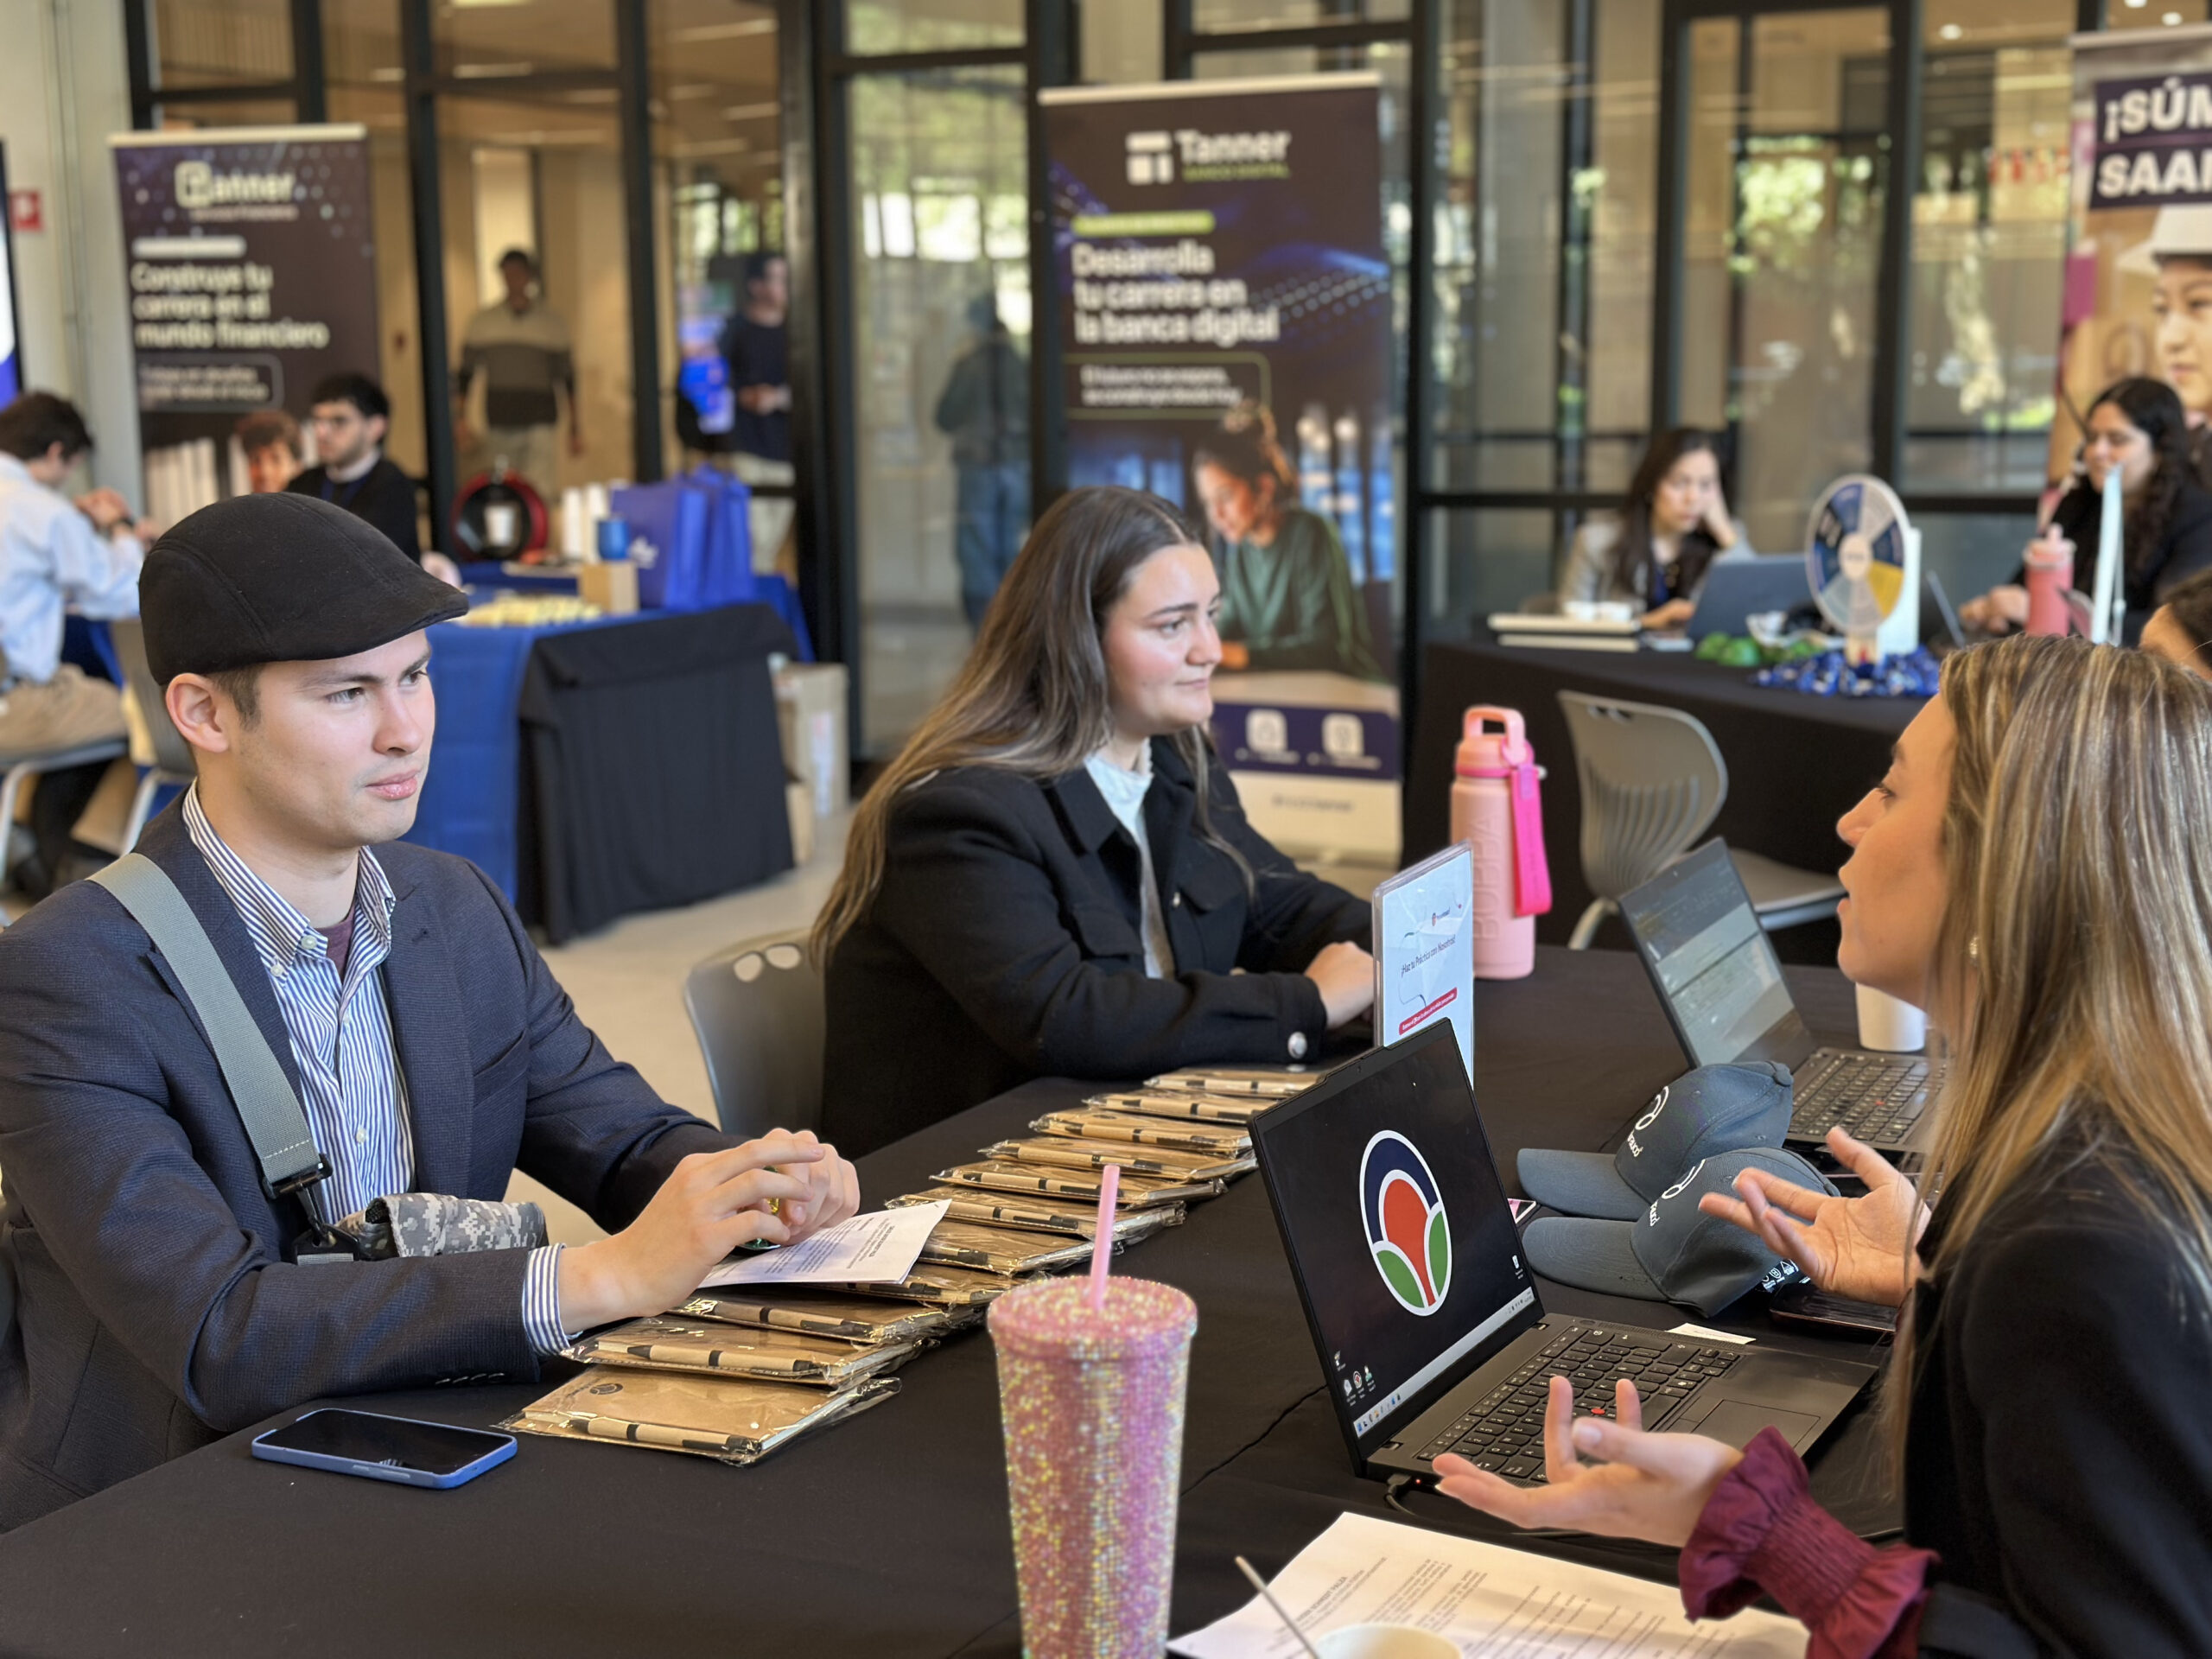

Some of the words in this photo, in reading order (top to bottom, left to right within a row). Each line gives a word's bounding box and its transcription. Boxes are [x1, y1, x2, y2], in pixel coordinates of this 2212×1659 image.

[1176, 130, 1291, 162] Tanner
[1072, 240, 1214, 276] Desarrolla
[132, 264, 243, 292] Construye
[245, 264, 272, 289] tu
[135, 296, 212, 318] carrera
[216, 296, 241, 317] en
[248, 293, 270, 316] el
[1074, 279, 1103, 308] tu
[1107, 281, 1206, 308] carrera
[1209, 279, 1247, 307] en
[137, 322, 213, 346] mundo
[218, 320, 328, 346] financiero
[1075, 311, 1100, 342] la
[1103, 309, 1190, 341] banca
[1192, 307, 1279, 346] digital
